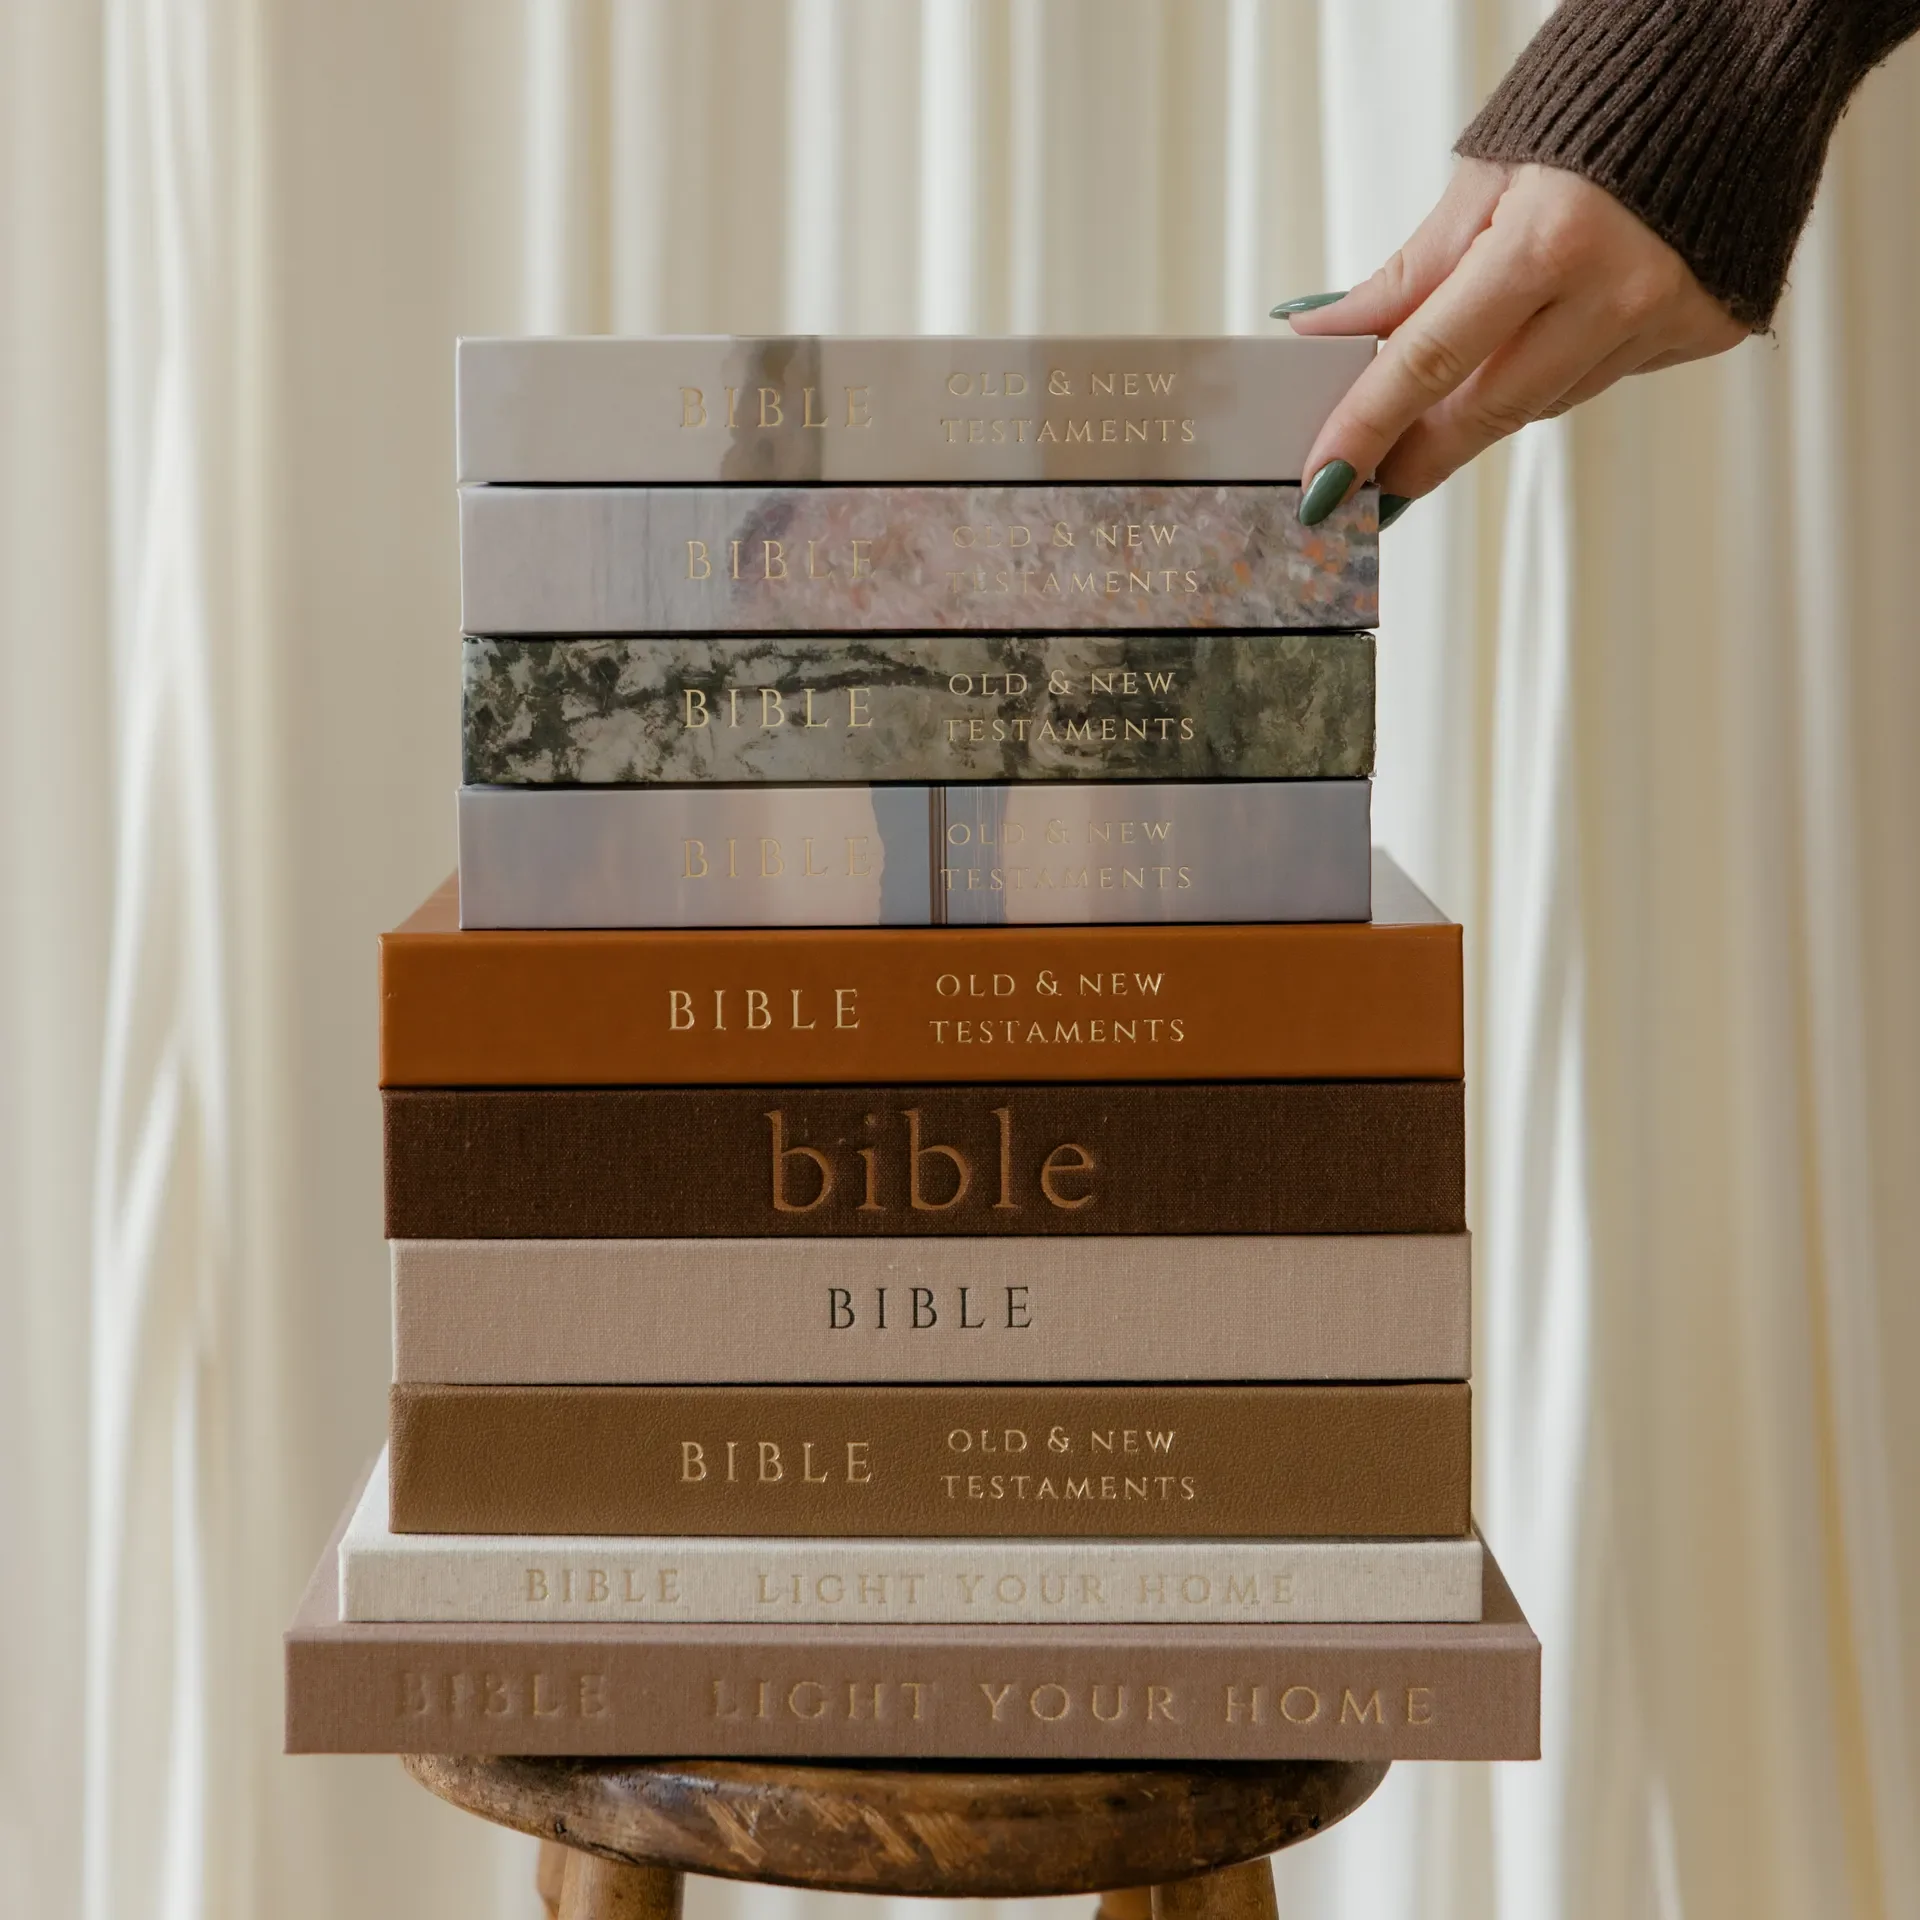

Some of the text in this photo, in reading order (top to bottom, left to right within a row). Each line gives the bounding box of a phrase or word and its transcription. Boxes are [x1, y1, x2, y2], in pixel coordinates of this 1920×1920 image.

[947, 370, 1177, 396] OLD & NEW
[679, 386, 873, 429] BIBLE
[940, 418, 1197, 443] TESTAMENTS
[952, 522, 1179, 548] OLD & NEW
[685, 540, 876, 581] BIBLE
[945, 570, 1198, 594] TESTAMENTS
[948, 670, 1176, 696] OLD & NEW
[683, 688, 874, 729] BIBLE
[943, 718, 1195, 742] TESTAMENTS
[947, 819, 1174, 846] OLD & NEW
[682, 837, 873, 879] BIBLE
[940, 866, 1194, 891] TESTAMENTS
[936, 970, 1165, 997] OLD & NEW
[669, 988, 861, 1031] BIBLE
[929, 1019, 1186, 1044] TESTAMENTS
[764, 1108, 1095, 1213] bible
[827, 1286, 1033, 1329] BIBLE
[947, 1426, 1177, 1453] OLD & NEW
[680, 1441, 873, 1483] BIBLE
[941, 1475, 1195, 1500] TESTAMENTS
[525, 1568, 1298, 1604] BIBLE LIGHT YOUR HOME
[404, 1671, 1435, 1726] BIBLE LIGHT YOUR HOME
